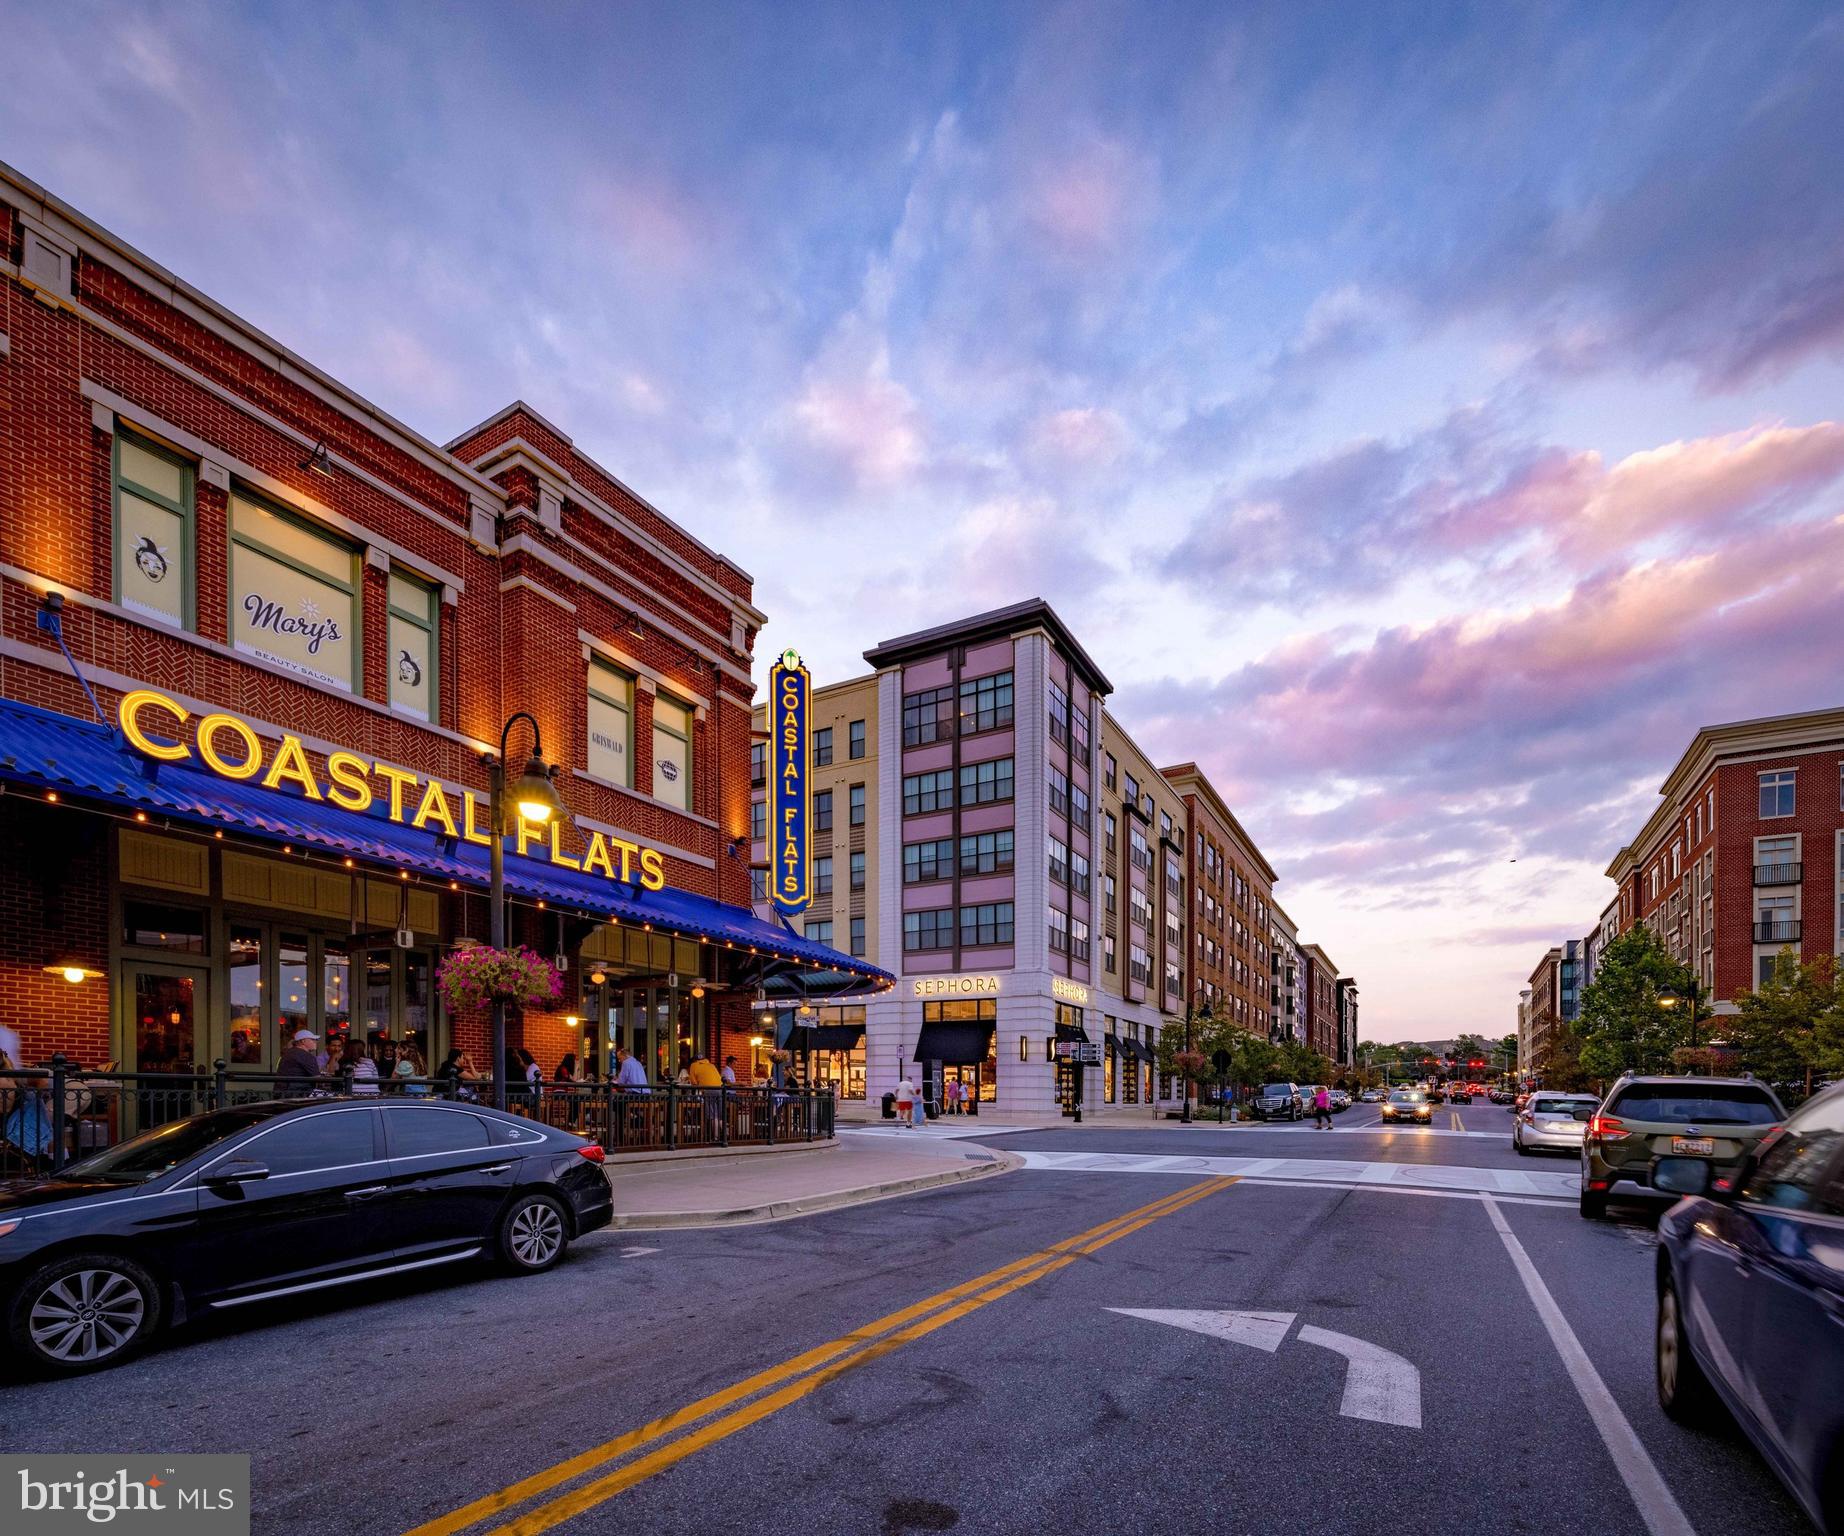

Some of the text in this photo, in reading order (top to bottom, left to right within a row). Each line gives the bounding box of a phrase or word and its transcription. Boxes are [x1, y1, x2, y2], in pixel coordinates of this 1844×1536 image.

[243, 594, 342, 655] Mary's
[255, 649, 334, 684] BEAUTY SALON
[119, 689, 665, 891] COASTAL FLATS
[782, 676, 799, 892] COASTAL FLATS
[915, 977, 997, 995] SEPHORA
[1053, 979, 1088, 1004] SEPHORA
